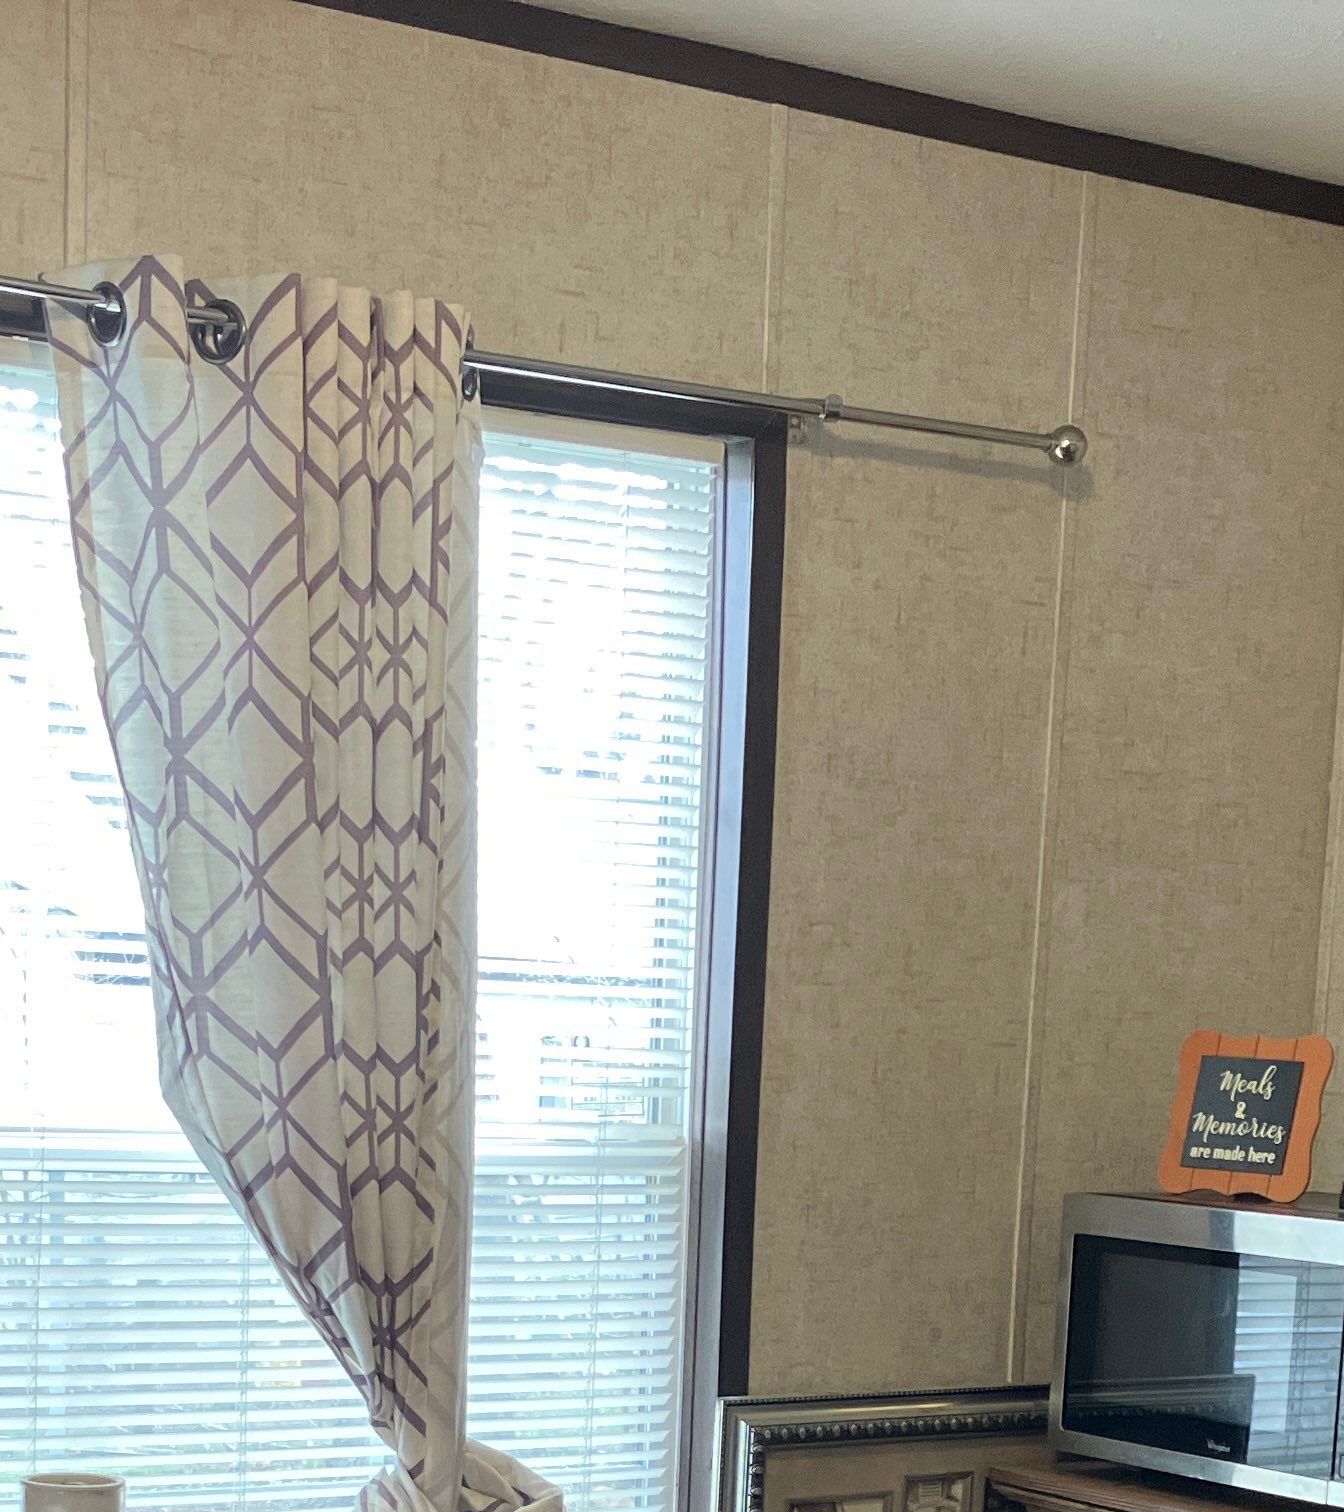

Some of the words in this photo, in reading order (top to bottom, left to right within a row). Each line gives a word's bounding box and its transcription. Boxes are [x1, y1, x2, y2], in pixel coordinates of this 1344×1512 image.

[1220, 1065, 1277, 1101] Meals
[1235, 1101, 1246, 1119] &
[1193, 1112, 1286, 1144] Memories
[1190, 1146, 1211, 1158] are
[1213, 1145, 1245, 1161] made
[1248, 1146, 1275, 1164] here
